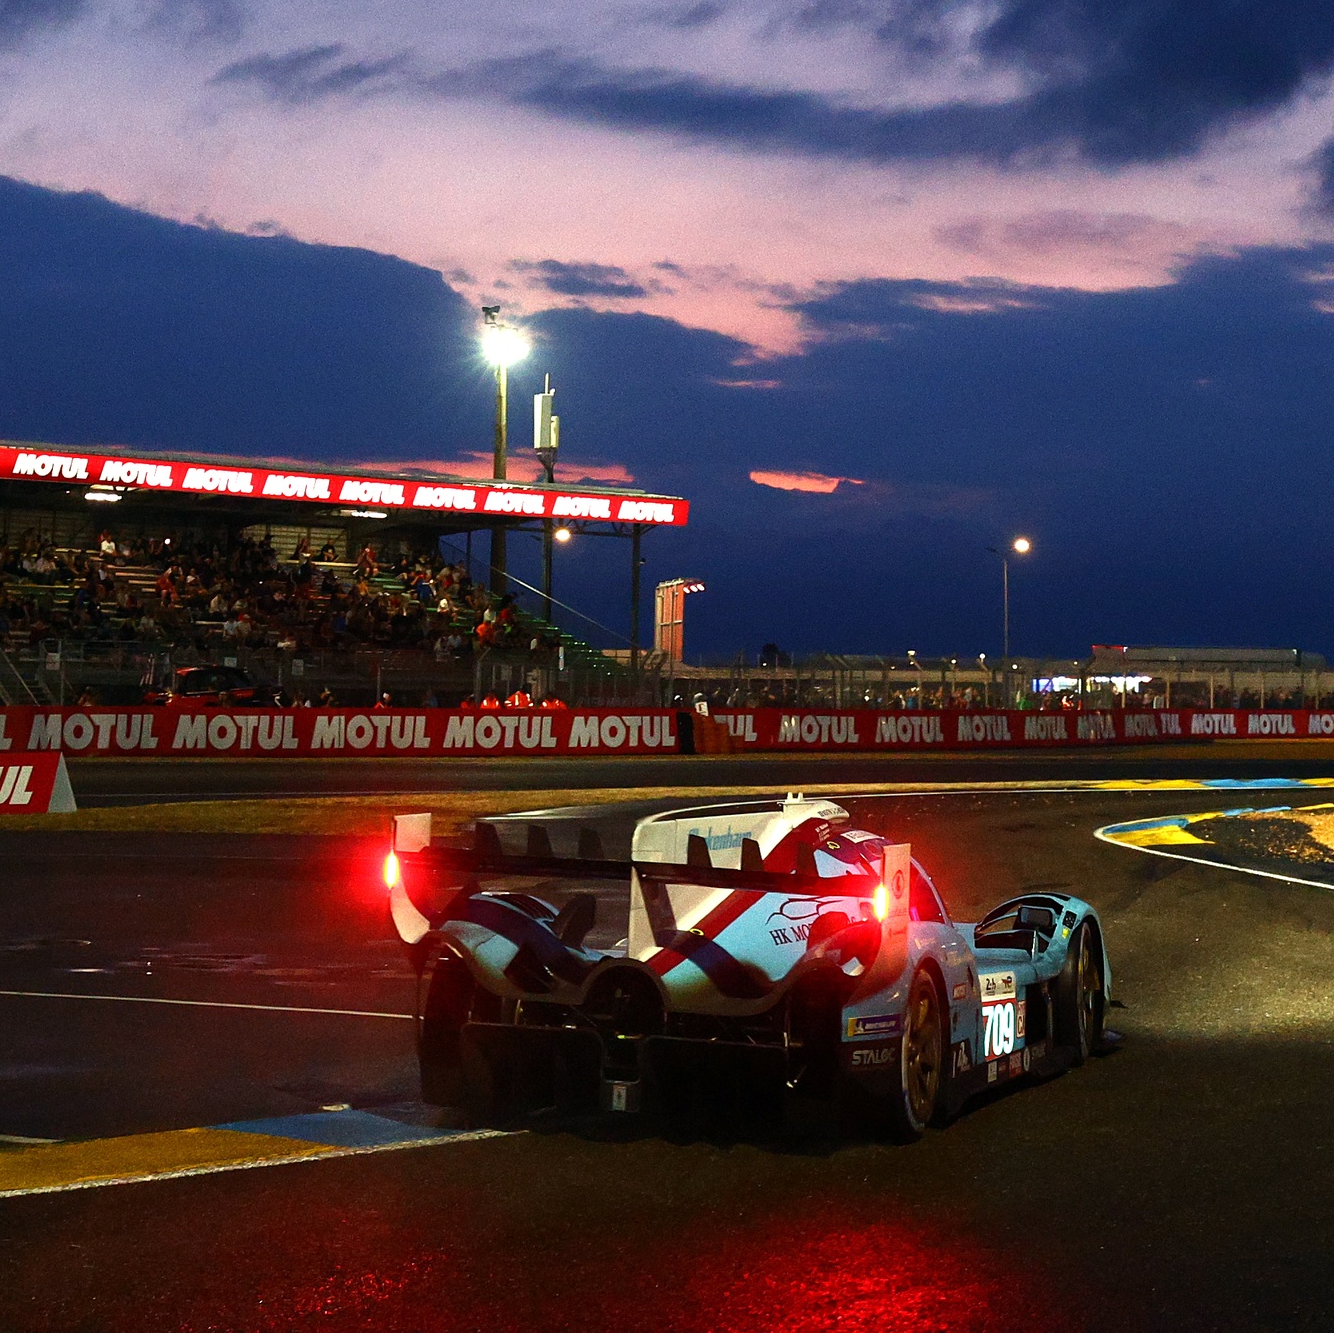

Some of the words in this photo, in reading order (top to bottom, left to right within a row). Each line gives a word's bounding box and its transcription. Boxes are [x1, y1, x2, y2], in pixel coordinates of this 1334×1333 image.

[13, 453, 89, 480] MOTUL
[99, 460, 174, 487] MOTUL
[182, 468, 254, 494] MOTUL
[262, 475, 331, 499] MOTUL
[339, 481, 405, 505] MOTUL
[413, 487, 477, 510] MOTUL
[484, 492, 546, 515] MOTUL
[552, 496, 612, 519] MOTUL
[618, 501, 675, 523] MOTUL
[28, 713, 159, 750] MOTUL
[173, 714, 299, 750] MOTUL
[312, 715, 431, 749] MOTUL
[444, 715, 558, 749] MOTUL
[569, 715, 676, 748] MOTUL
[779, 714, 859, 744] MOTUL
[875, 715, 944, 743] MOTUL
[958, 715, 1012, 741] MOTUL
[1024, 714, 1068, 740] MOTUL
[1190, 714, 1239, 735] MOTUL
[1247, 714, 1296, 735] MOTUL
[981, 1002, 1015, 1057] 709
